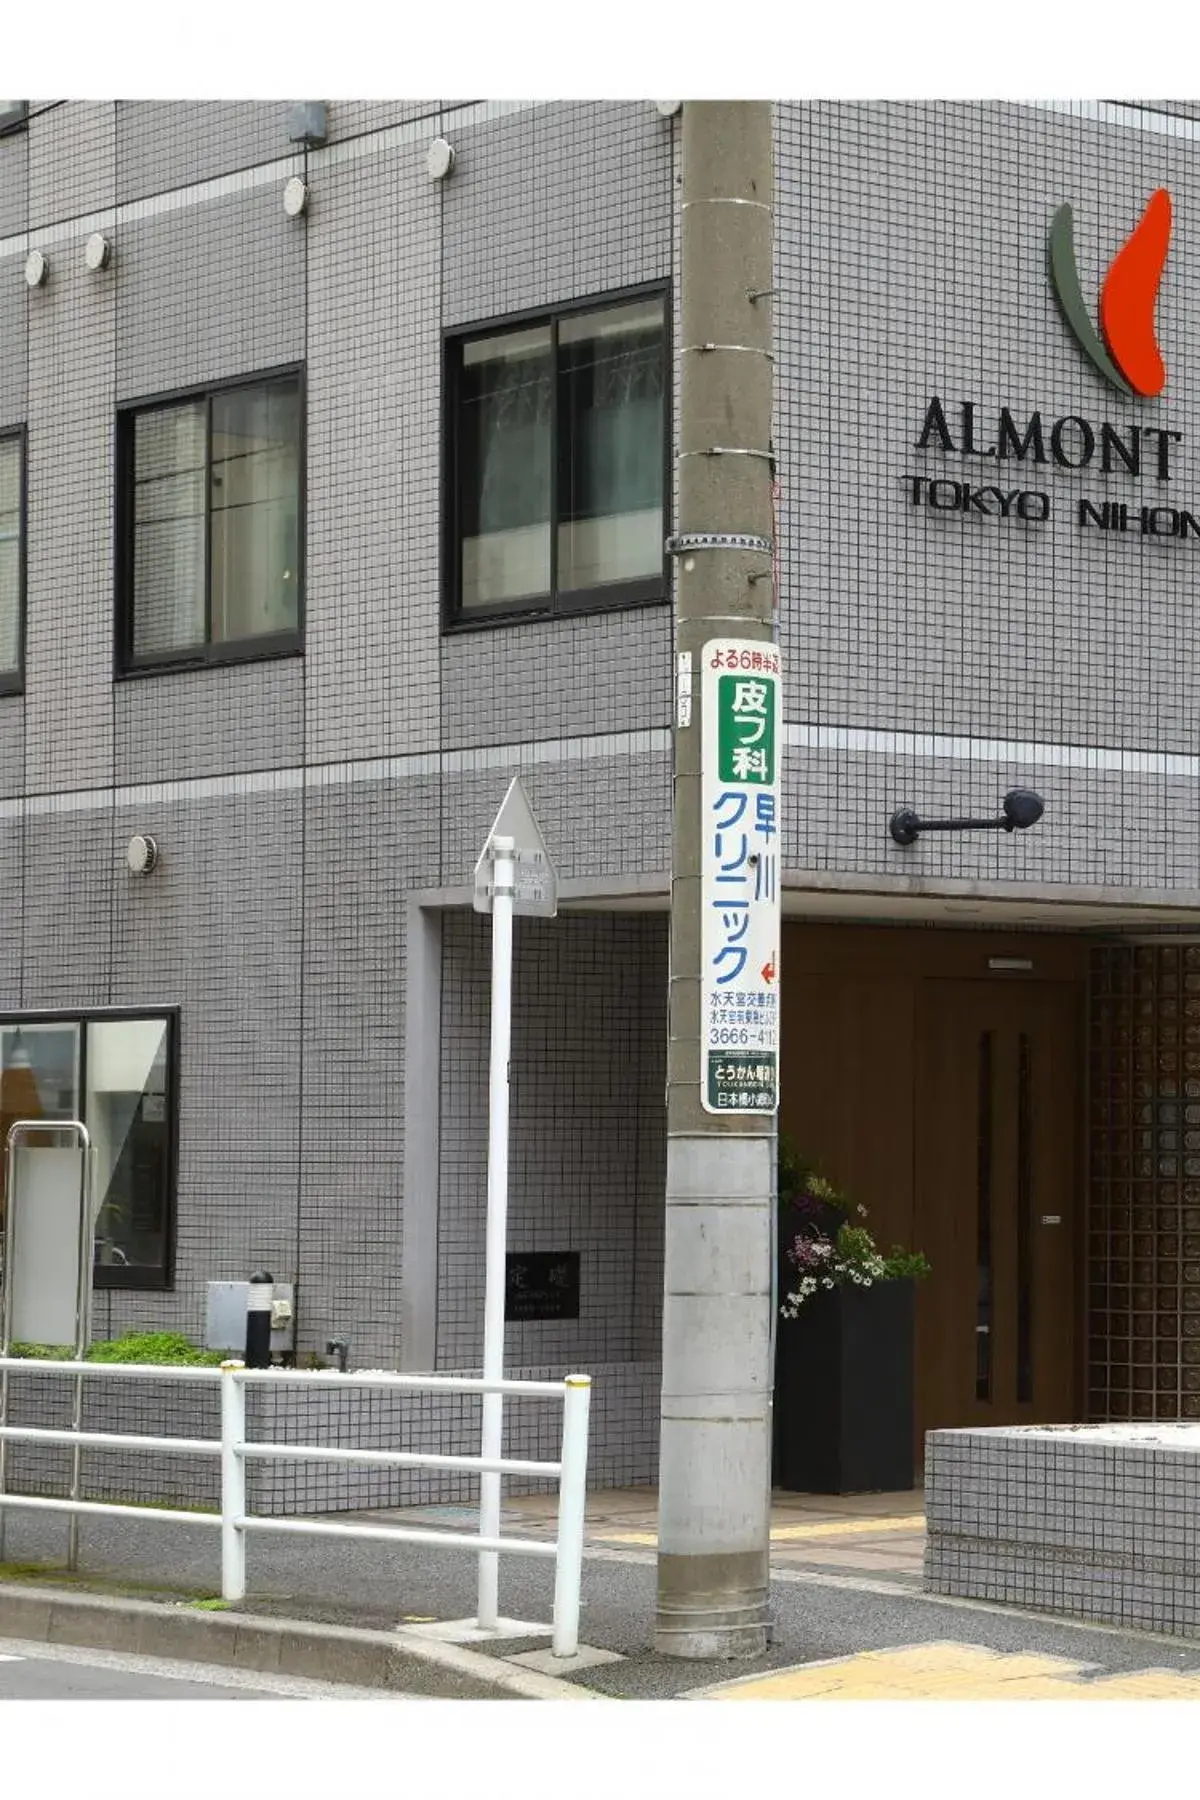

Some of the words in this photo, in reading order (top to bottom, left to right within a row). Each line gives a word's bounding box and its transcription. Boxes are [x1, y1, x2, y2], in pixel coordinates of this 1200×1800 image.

[914, 396, 1182, 481] ALMONT
[902, 475, 1051, 522] TOKYO
[732, 680, 768, 782] 皮フ科
[712, 791, 749, 985] クリニック
[754, 792, 777, 903] 早川
